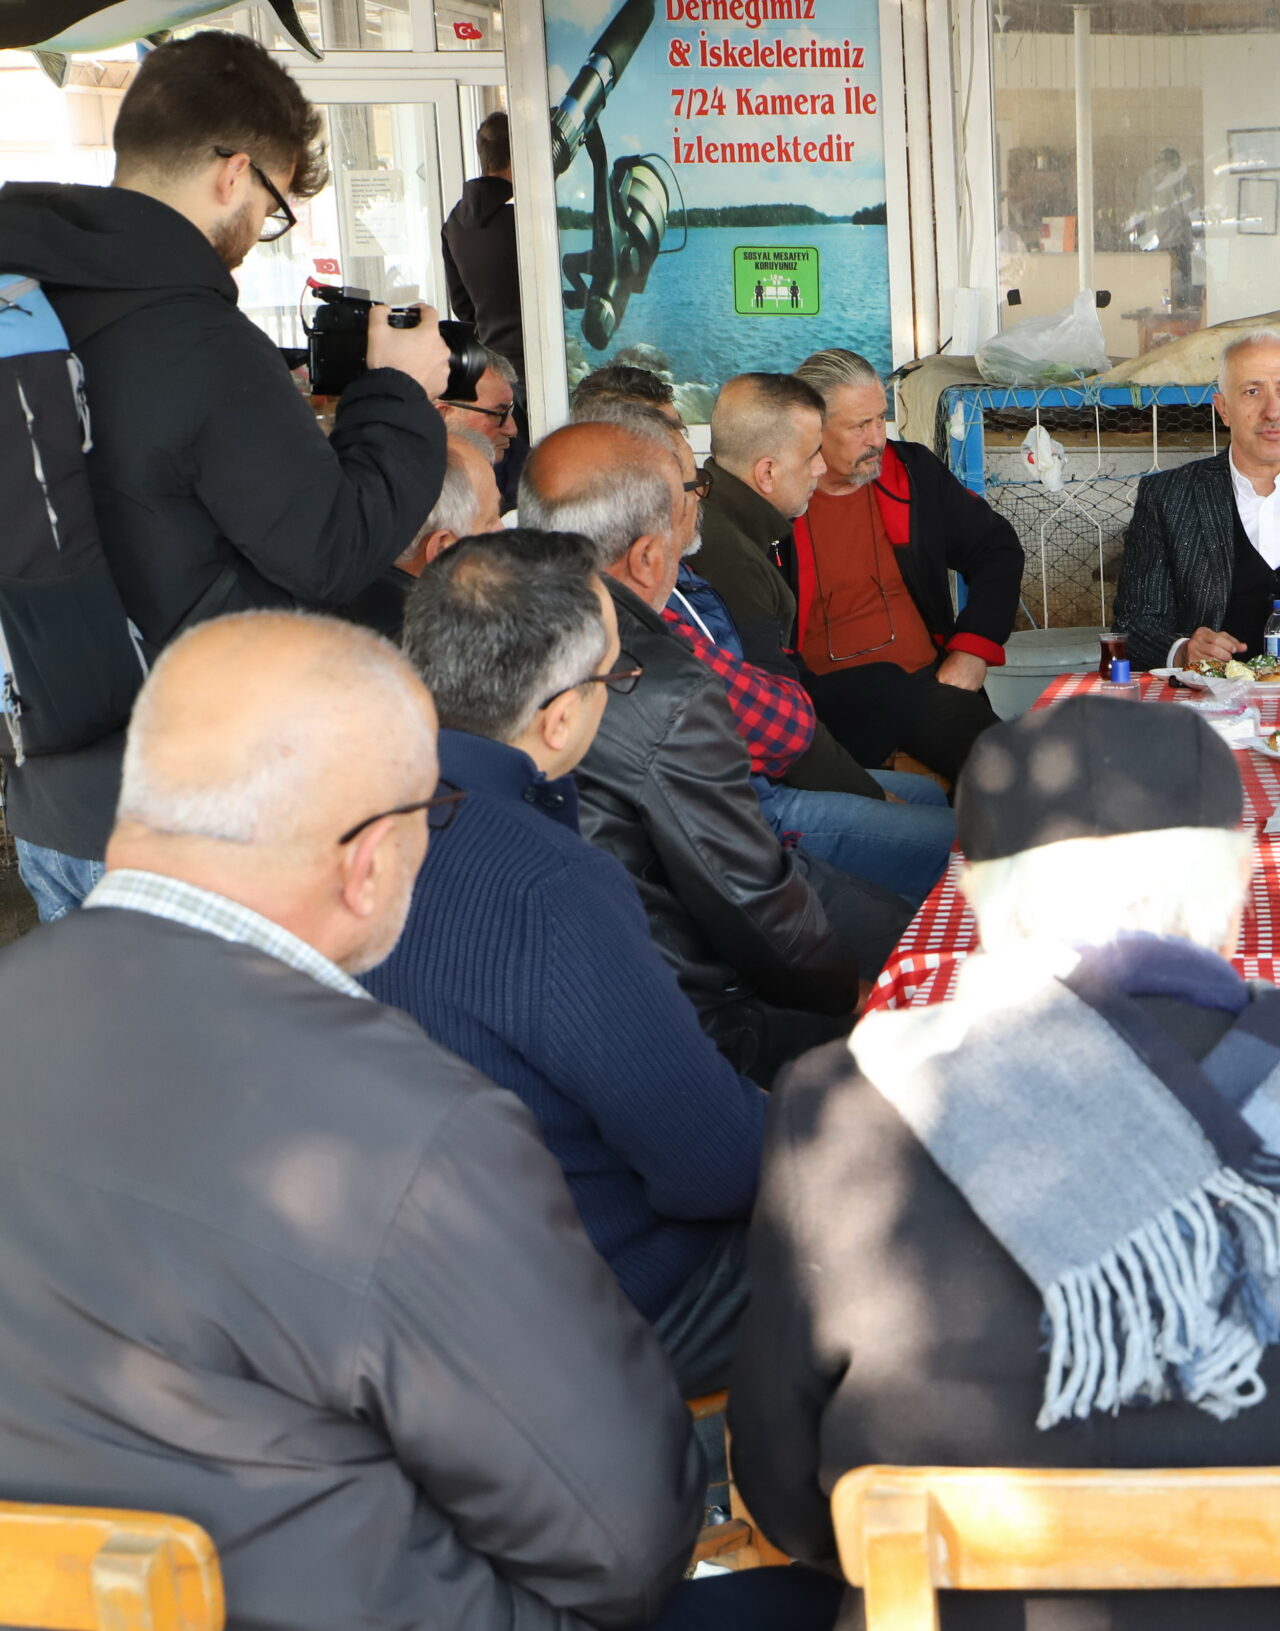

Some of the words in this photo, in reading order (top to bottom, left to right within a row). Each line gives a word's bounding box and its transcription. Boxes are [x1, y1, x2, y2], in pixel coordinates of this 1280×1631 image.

[668, 39, 691, 67] &
[699, 30, 865, 68] İskelelerimiz
[670, 86, 727, 120] 7/24
[735, 87, 836, 116] Kamera
[844, 77, 877, 116] İle
[672, 127, 855, 164] İzlenmektedir
[743, 251, 771, 260] SOSYAL
[773, 250, 809, 261] MESAFEYİ
[755, 261, 798, 270] KORUYUNUZ
